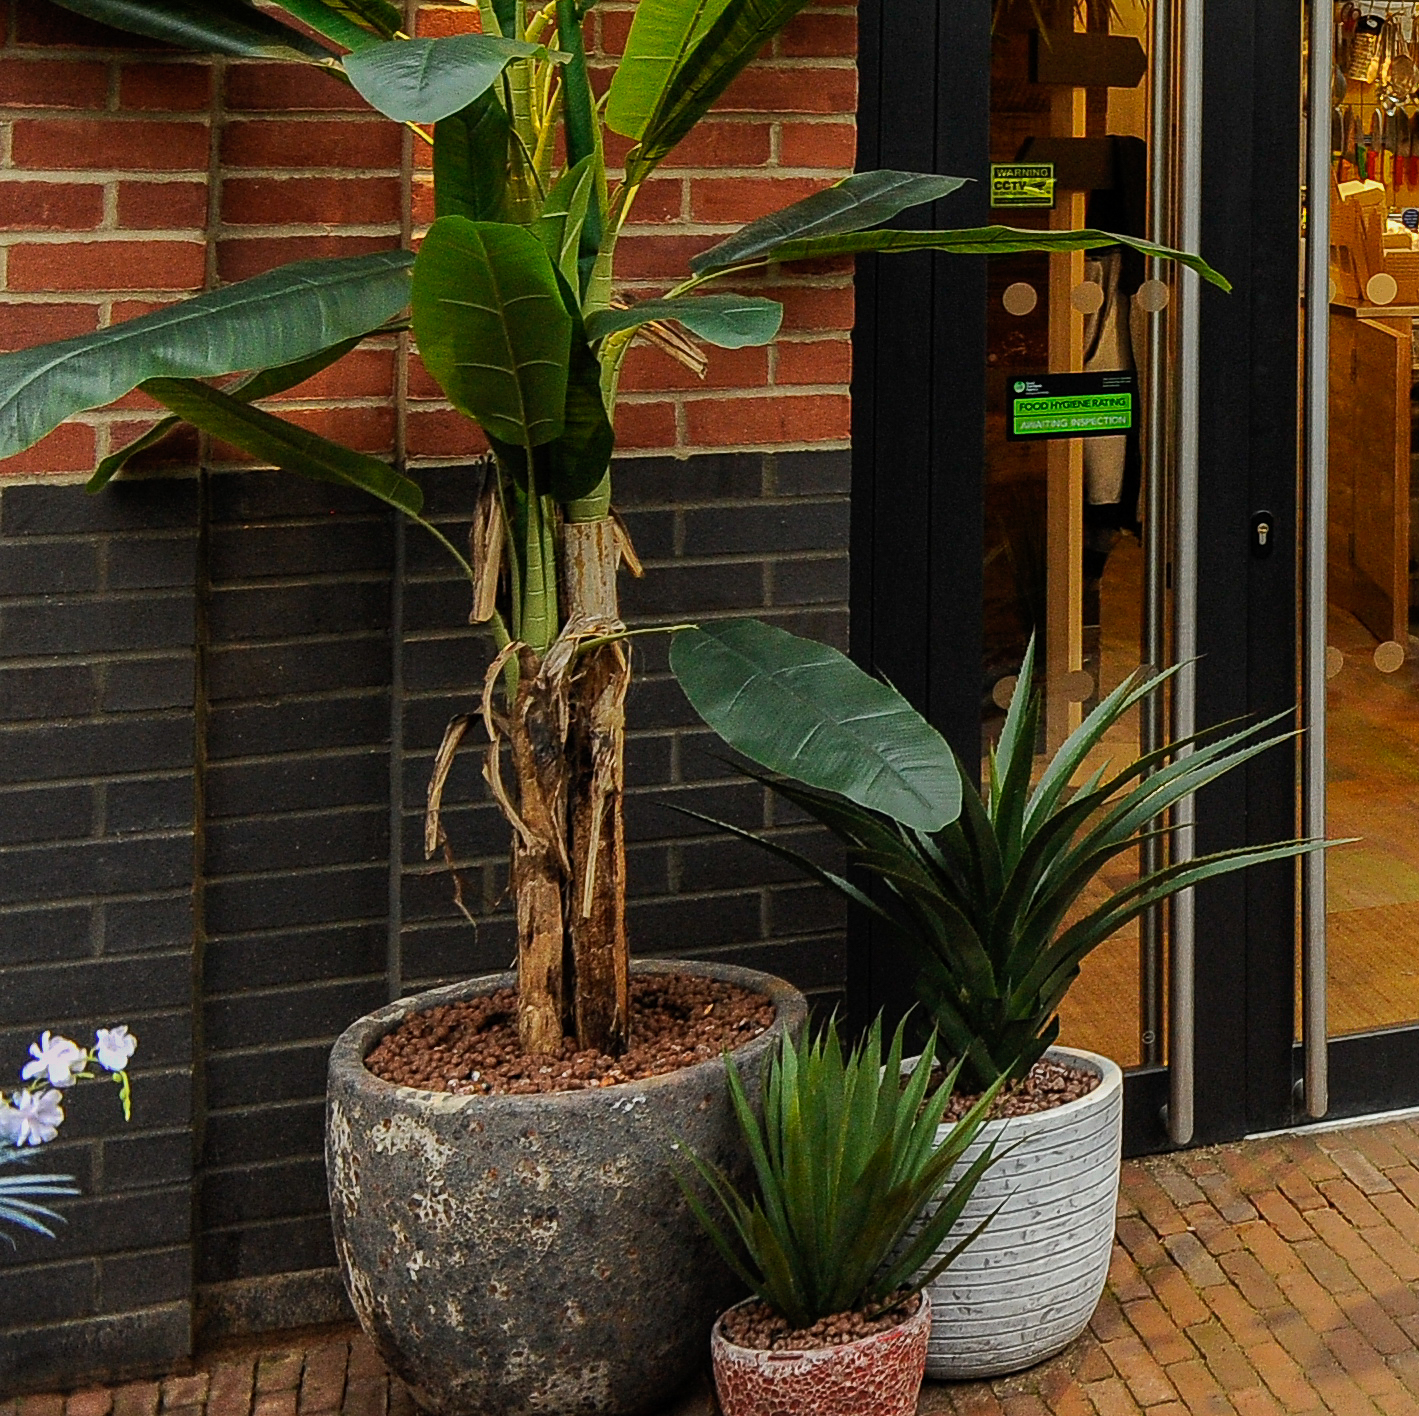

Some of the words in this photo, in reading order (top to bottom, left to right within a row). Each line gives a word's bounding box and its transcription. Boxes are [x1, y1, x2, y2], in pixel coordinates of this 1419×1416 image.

[996, 168, 1048, 177] WARNING
[993, 180, 1027, 190] CCTV
[1019, 401, 1049, 412] FOOD
[1050, 399, 1091, 410] HYGIENE
[1091, 397, 1126, 407] RATING
[1020, 418, 1068, 429] AWAITING
[1070, 415, 1126, 427] INSPECTION
